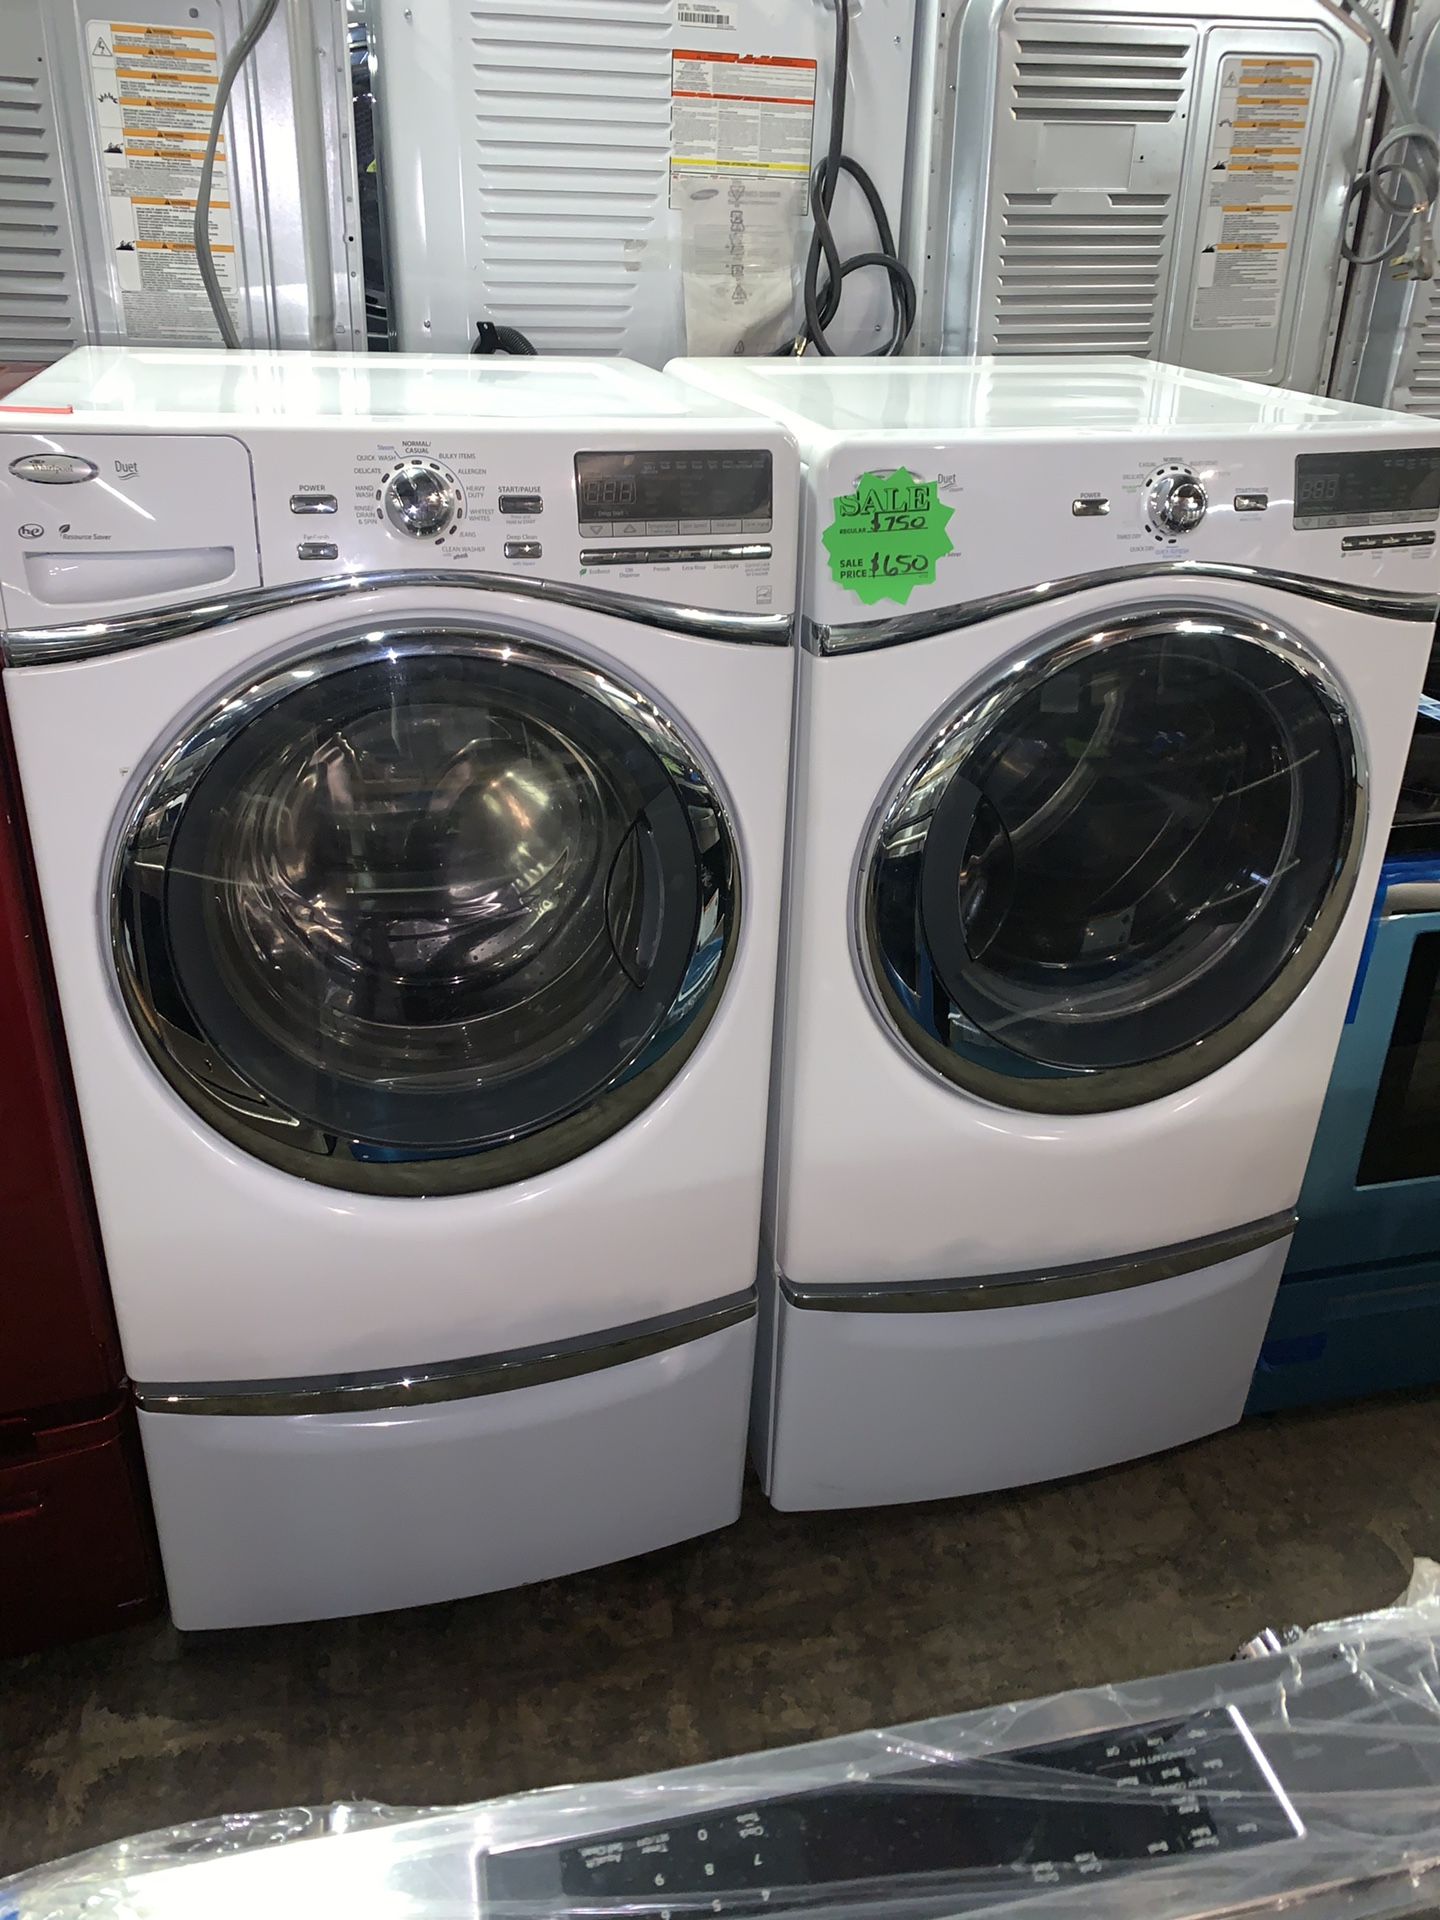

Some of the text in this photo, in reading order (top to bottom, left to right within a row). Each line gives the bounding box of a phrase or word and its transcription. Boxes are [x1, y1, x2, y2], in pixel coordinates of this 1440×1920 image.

[402, 440, 431, 448] NORMAL/
[405, 446, 430, 454] CASUAL
[356, 454, 396, 462] QUICK WASH
[114, 460, 139, 473] Duet
[354, 467, 382, 475] DELICATE
[937, 473, 957, 485] Duet
[298, 484, 326, 492] POWER
[497, 485, 542, 494] START/PAUSE
[356, 491, 374, 499] WASH
[468, 491, 485, 499] DUTY
[839, 486, 931, 518] SALE
[356, 511, 376, 519] DRAIN
[839, 511, 926, 535] REGULAR $750
[63, 533, 112, 541] Resource Saver
[441, 546, 486, 554] CLEAN WASHER
[839, 558, 864, 568] SALE
[839, 551, 929, 579] PRICE $650
[753, 1852, 764, 1867] 7
[704, 1862, 715, 1877] 8
[711, 1898, 722, 1913] 5
